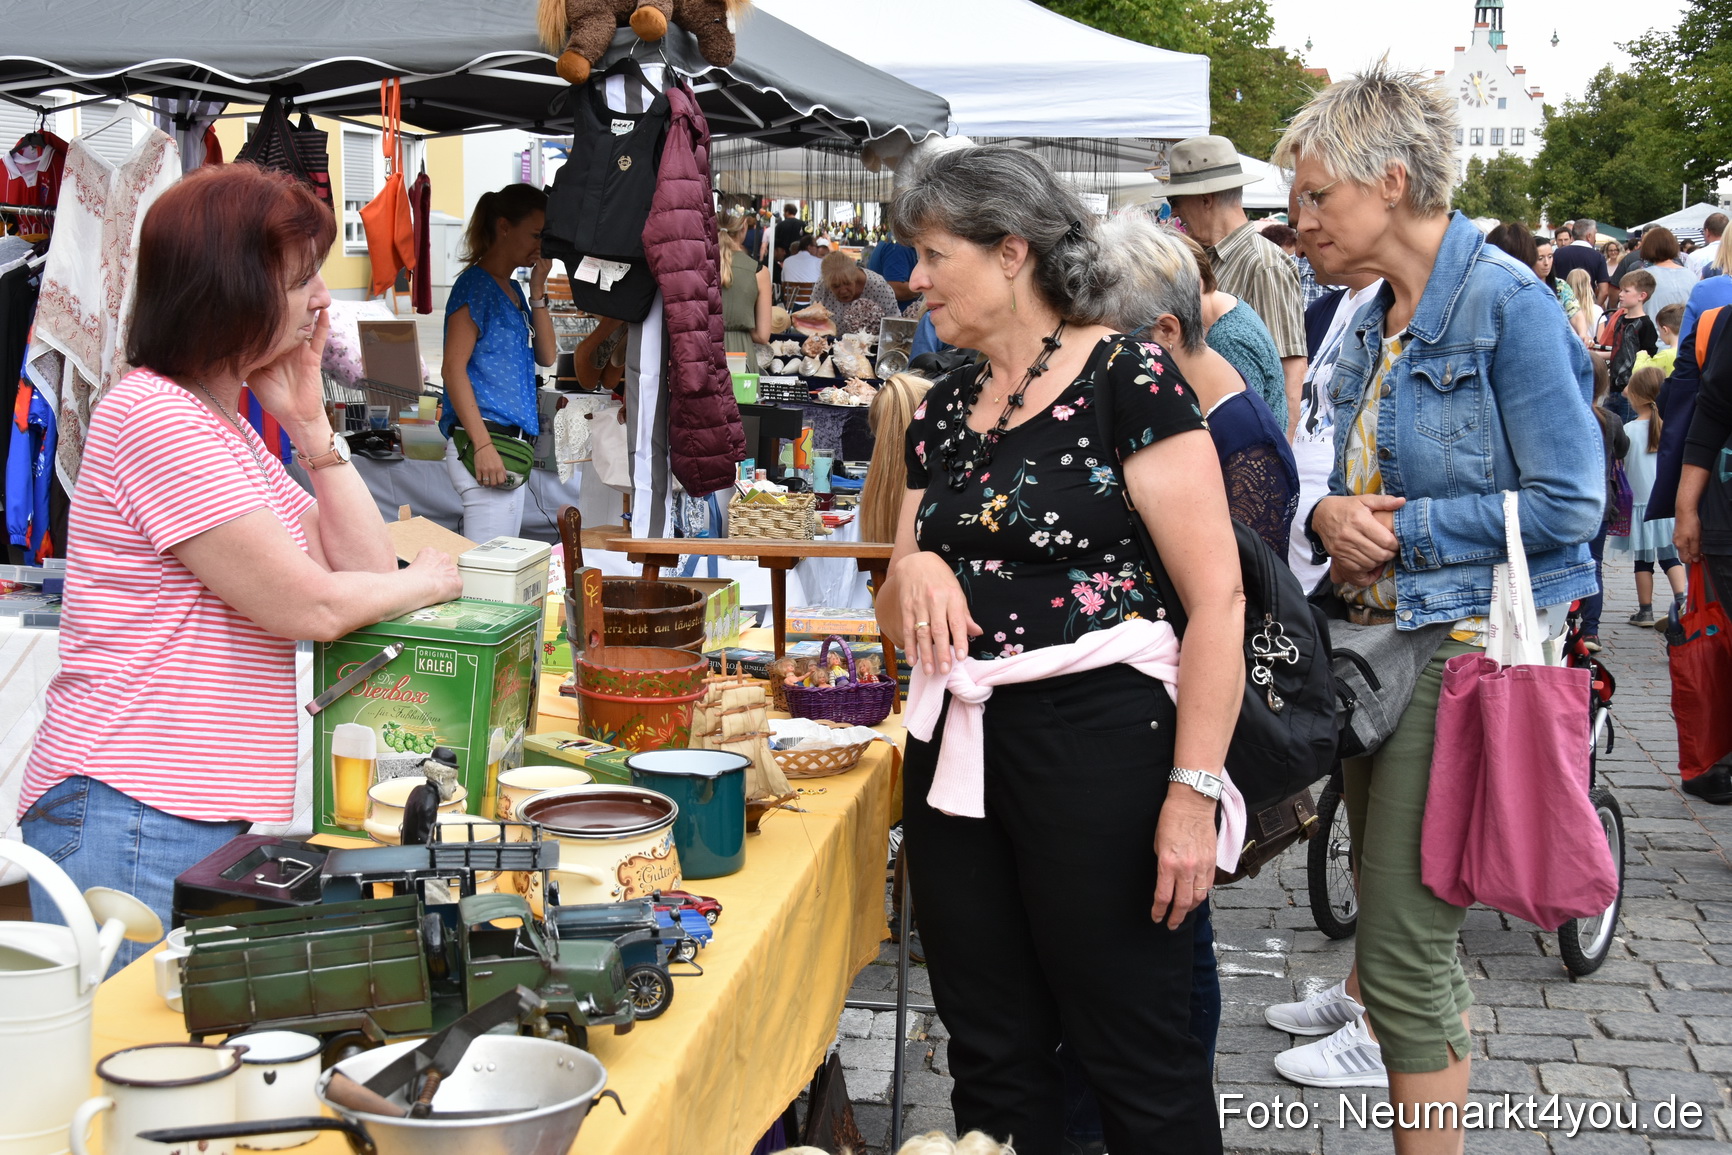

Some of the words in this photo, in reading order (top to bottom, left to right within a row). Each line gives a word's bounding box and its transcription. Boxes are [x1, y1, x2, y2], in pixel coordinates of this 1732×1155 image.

[603, 625, 623, 634] erz
[628, 624, 648, 634] lebt
[654, 625, 670, 633] am
[1489, 623, 1499, 638] dm
[419, 649, 453, 660] ORIGINAL
[418, 659, 453, 674] KALEA
[377, 672, 394, 685] Die
[642, 864, 673, 883] Guten
